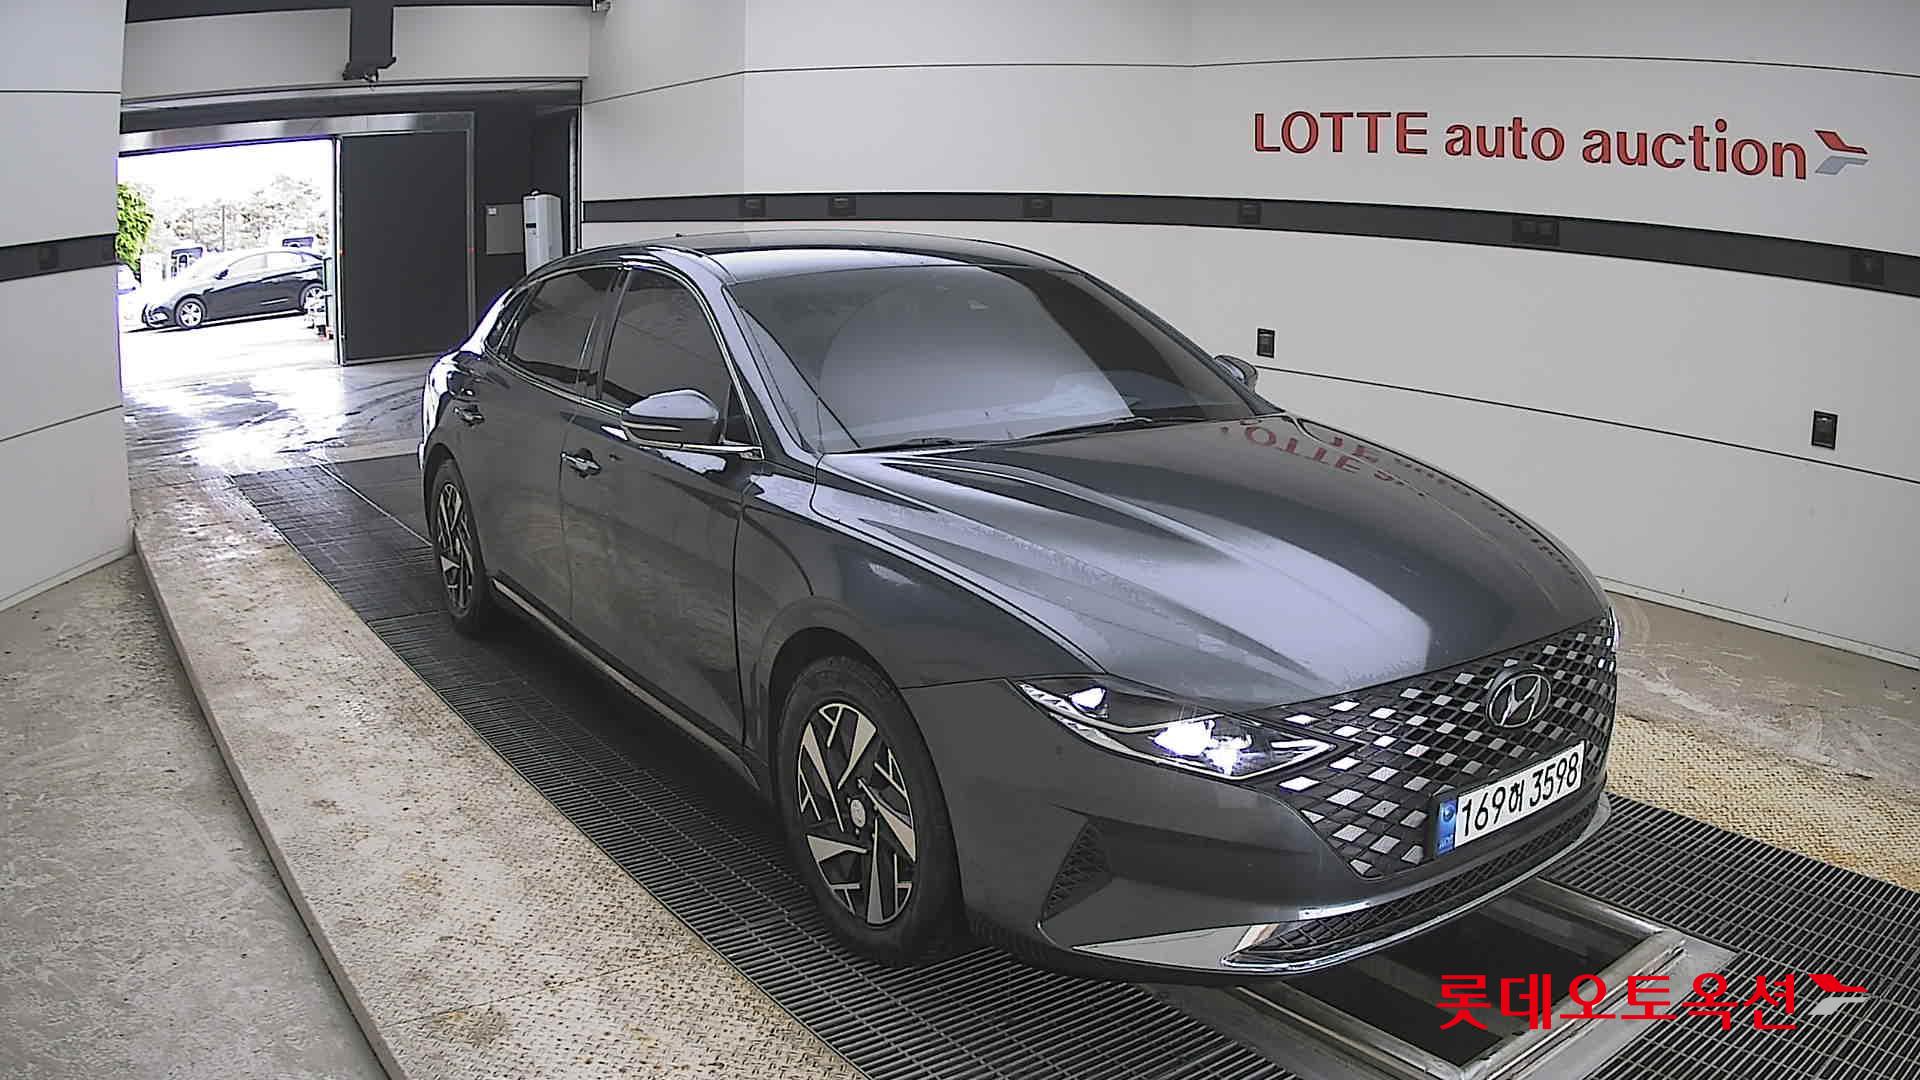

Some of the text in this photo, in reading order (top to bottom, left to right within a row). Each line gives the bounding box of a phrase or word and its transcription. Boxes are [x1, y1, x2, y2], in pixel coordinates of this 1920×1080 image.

[1254, 112, 1807, 180] LOTTE auto auction
[1461, 751, 1580, 837] 169허 3598
